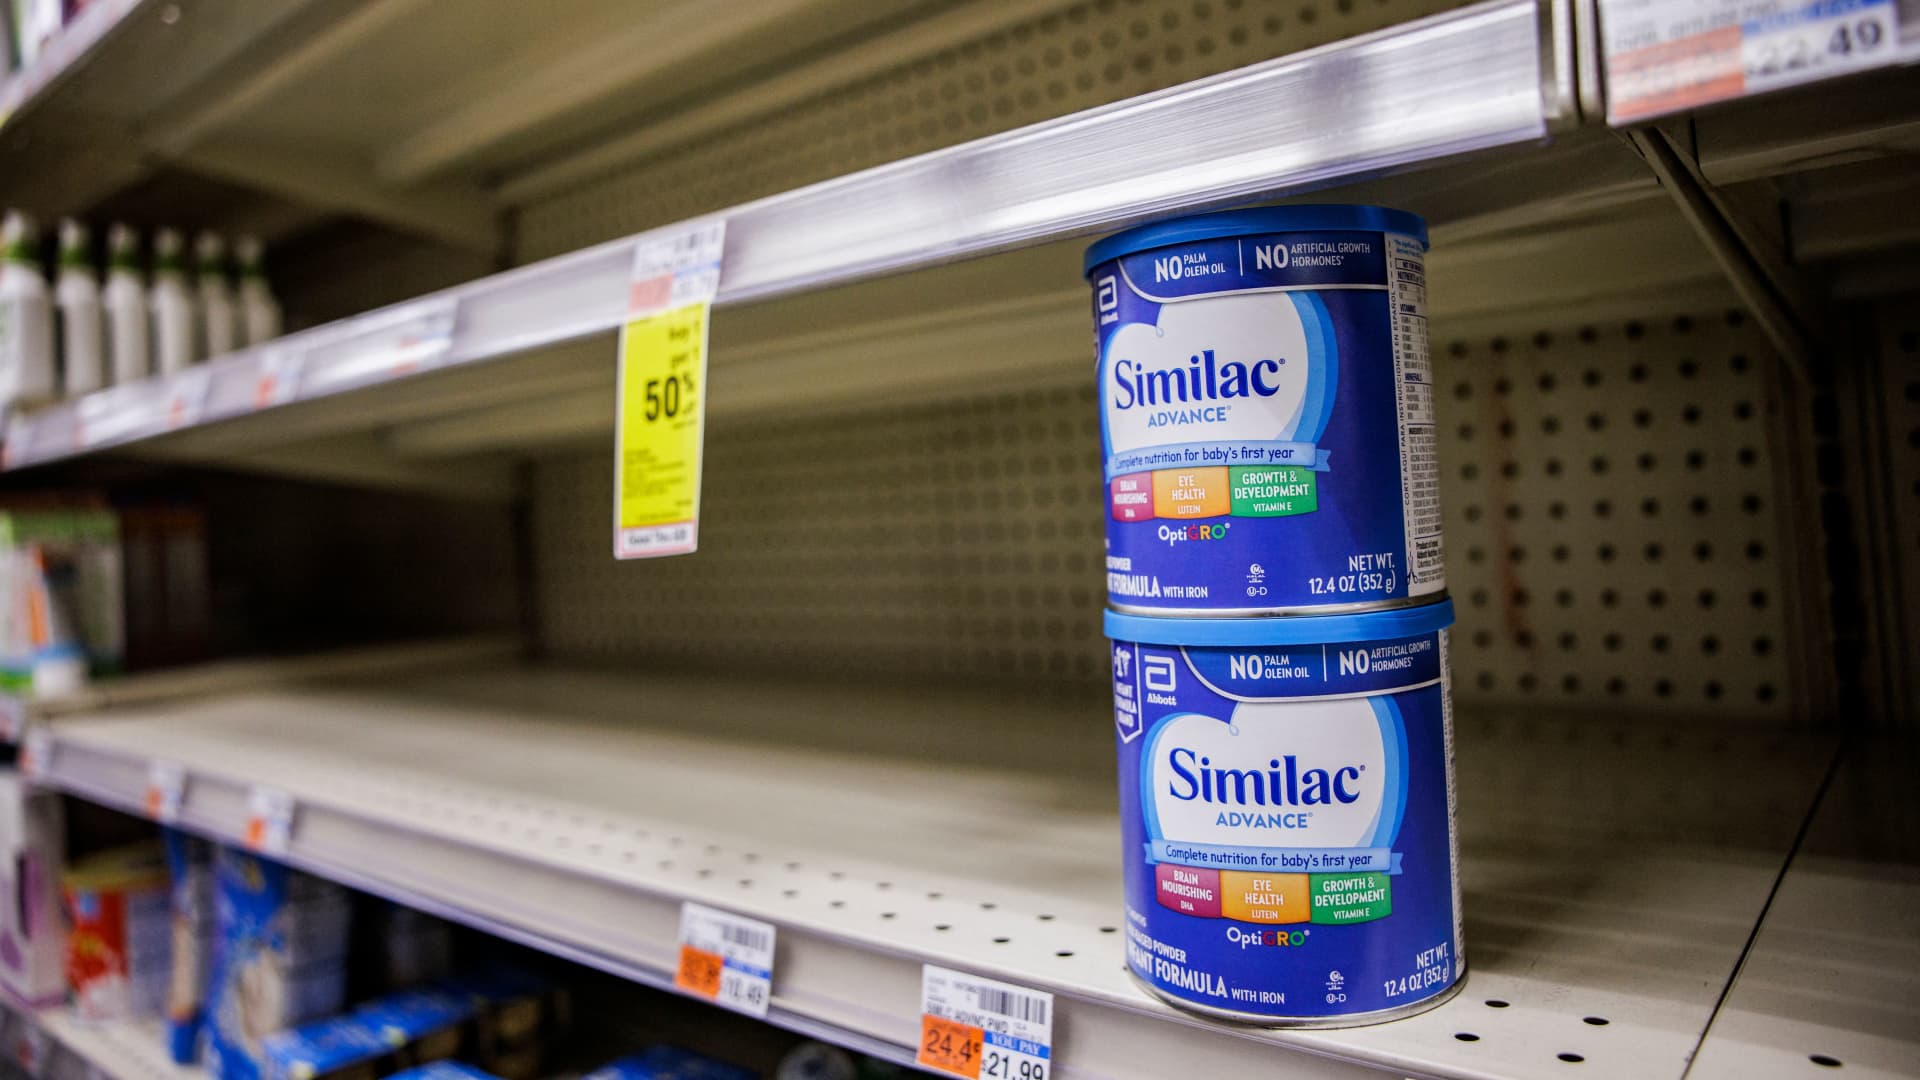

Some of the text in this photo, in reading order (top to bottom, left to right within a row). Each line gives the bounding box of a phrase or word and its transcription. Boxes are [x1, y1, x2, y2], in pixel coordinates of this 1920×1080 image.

[1255, 243, 1289, 270] NO
[1290, 242, 1370, 255] ARTIFICIAL GROWTH
[1184, 252, 1206, 265] PALM
[1155, 255, 1183, 283] NO
[1184, 262, 1226, 278] OLEIN OIL
[1144, 450, 1182, 464] nutrition
[1184, 448, 1200, 462] for
[1202, 445, 1238, 464] baby's
[1241, 446, 1264, 459] first
[1268, 448, 1294, 463] year
[1178, 475, 1195, 487] EYE
[1242, 471, 1298, 485] GROWTH &
[1172, 488, 1206, 502] HEALTH
[1234, 484, 1309, 499] DEVELOPMENT
[1177, 504, 1200, 514] LUTEIN
[1252, 502, 1293, 513] VITAMIN E
[1348, 552, 1396, 572] NET WT.
[1308, 570, 1396, 594] 12.4 OZ (352 g)
[1163, 586, 1184, 599] WITH
[1186, 586, 1208, 599] IRON
[1371, 640, 1432, 660] ARTIFICIAL GROWTH
[1230, 654, 1262, 680] NO
[1264, 654, 1290, 666] PALM
[1339, 649, 1370, 676] NO
[1264, 667, 1310, 679] OLEIN OIL
[1146, 693, 1177, 706] Abbott
[1166, 844, 1373, 871] Complete nutrition for baby's first year
[1173, 869, 1198, 885] BRAIN
[1322, 877, 1376, 893] GROWTH &
[1162, 880, 1214, 901] NOURISHING
[1253, 880, 1272, 892] EYE
[1180, 900, 1194, 912] DHA
[1244, 892, 1284, 906] HEALTH
[1314, 889, 1385, 908] DEVELOPMENT
[1251, 909, 1279, 920] LUTEIN
[1333, 907, 1371, 921] VITAMIN E
[1153, 940, 1187, 964] POWDER
[1416, 942, 1449, 970] NET WT.
[1155, 959, 1228, 999] FORMULA
[1231, 988, 1257, 1003] WITH
[1259, 992, 1285, 1005] IRON
[1384, 977, 1407, 998] 12.4
[1408, 972, 1422, 992] OZ
[991, 1033, 1018, 1050] YOU
[1019, 1040, 1041, 1056] PAY
